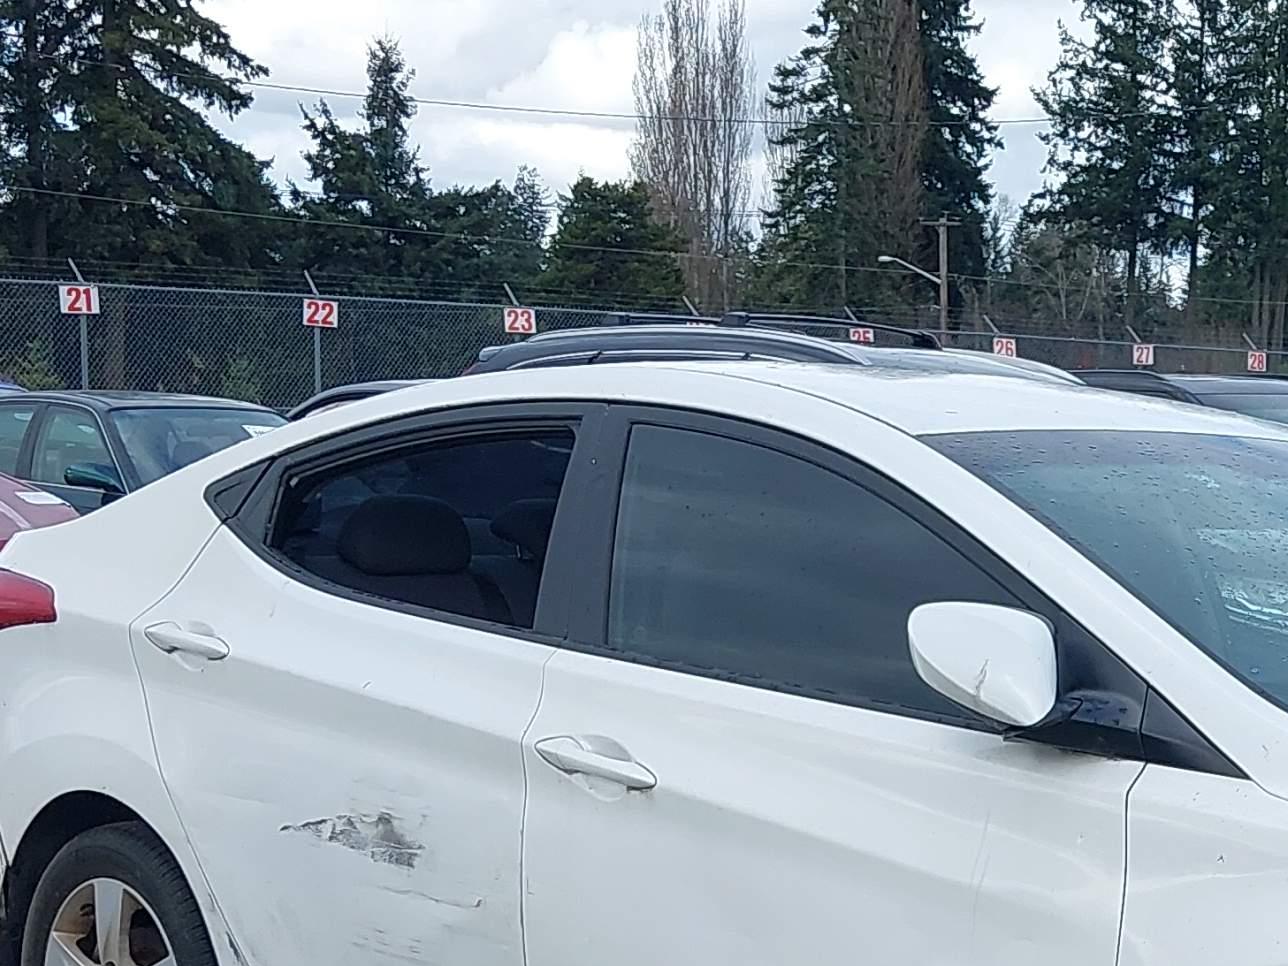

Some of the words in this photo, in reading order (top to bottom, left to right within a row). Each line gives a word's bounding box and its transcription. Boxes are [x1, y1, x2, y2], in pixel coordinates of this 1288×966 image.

[66, 287, 93, 313] 21
[306, 301, 335, 326] 22
[507, 309, 533, 332] 23
[995, 339, 1014, 357] 26
[1135, 346, 1151, 364] 27
[1249, 353, 1265, 371] 28
